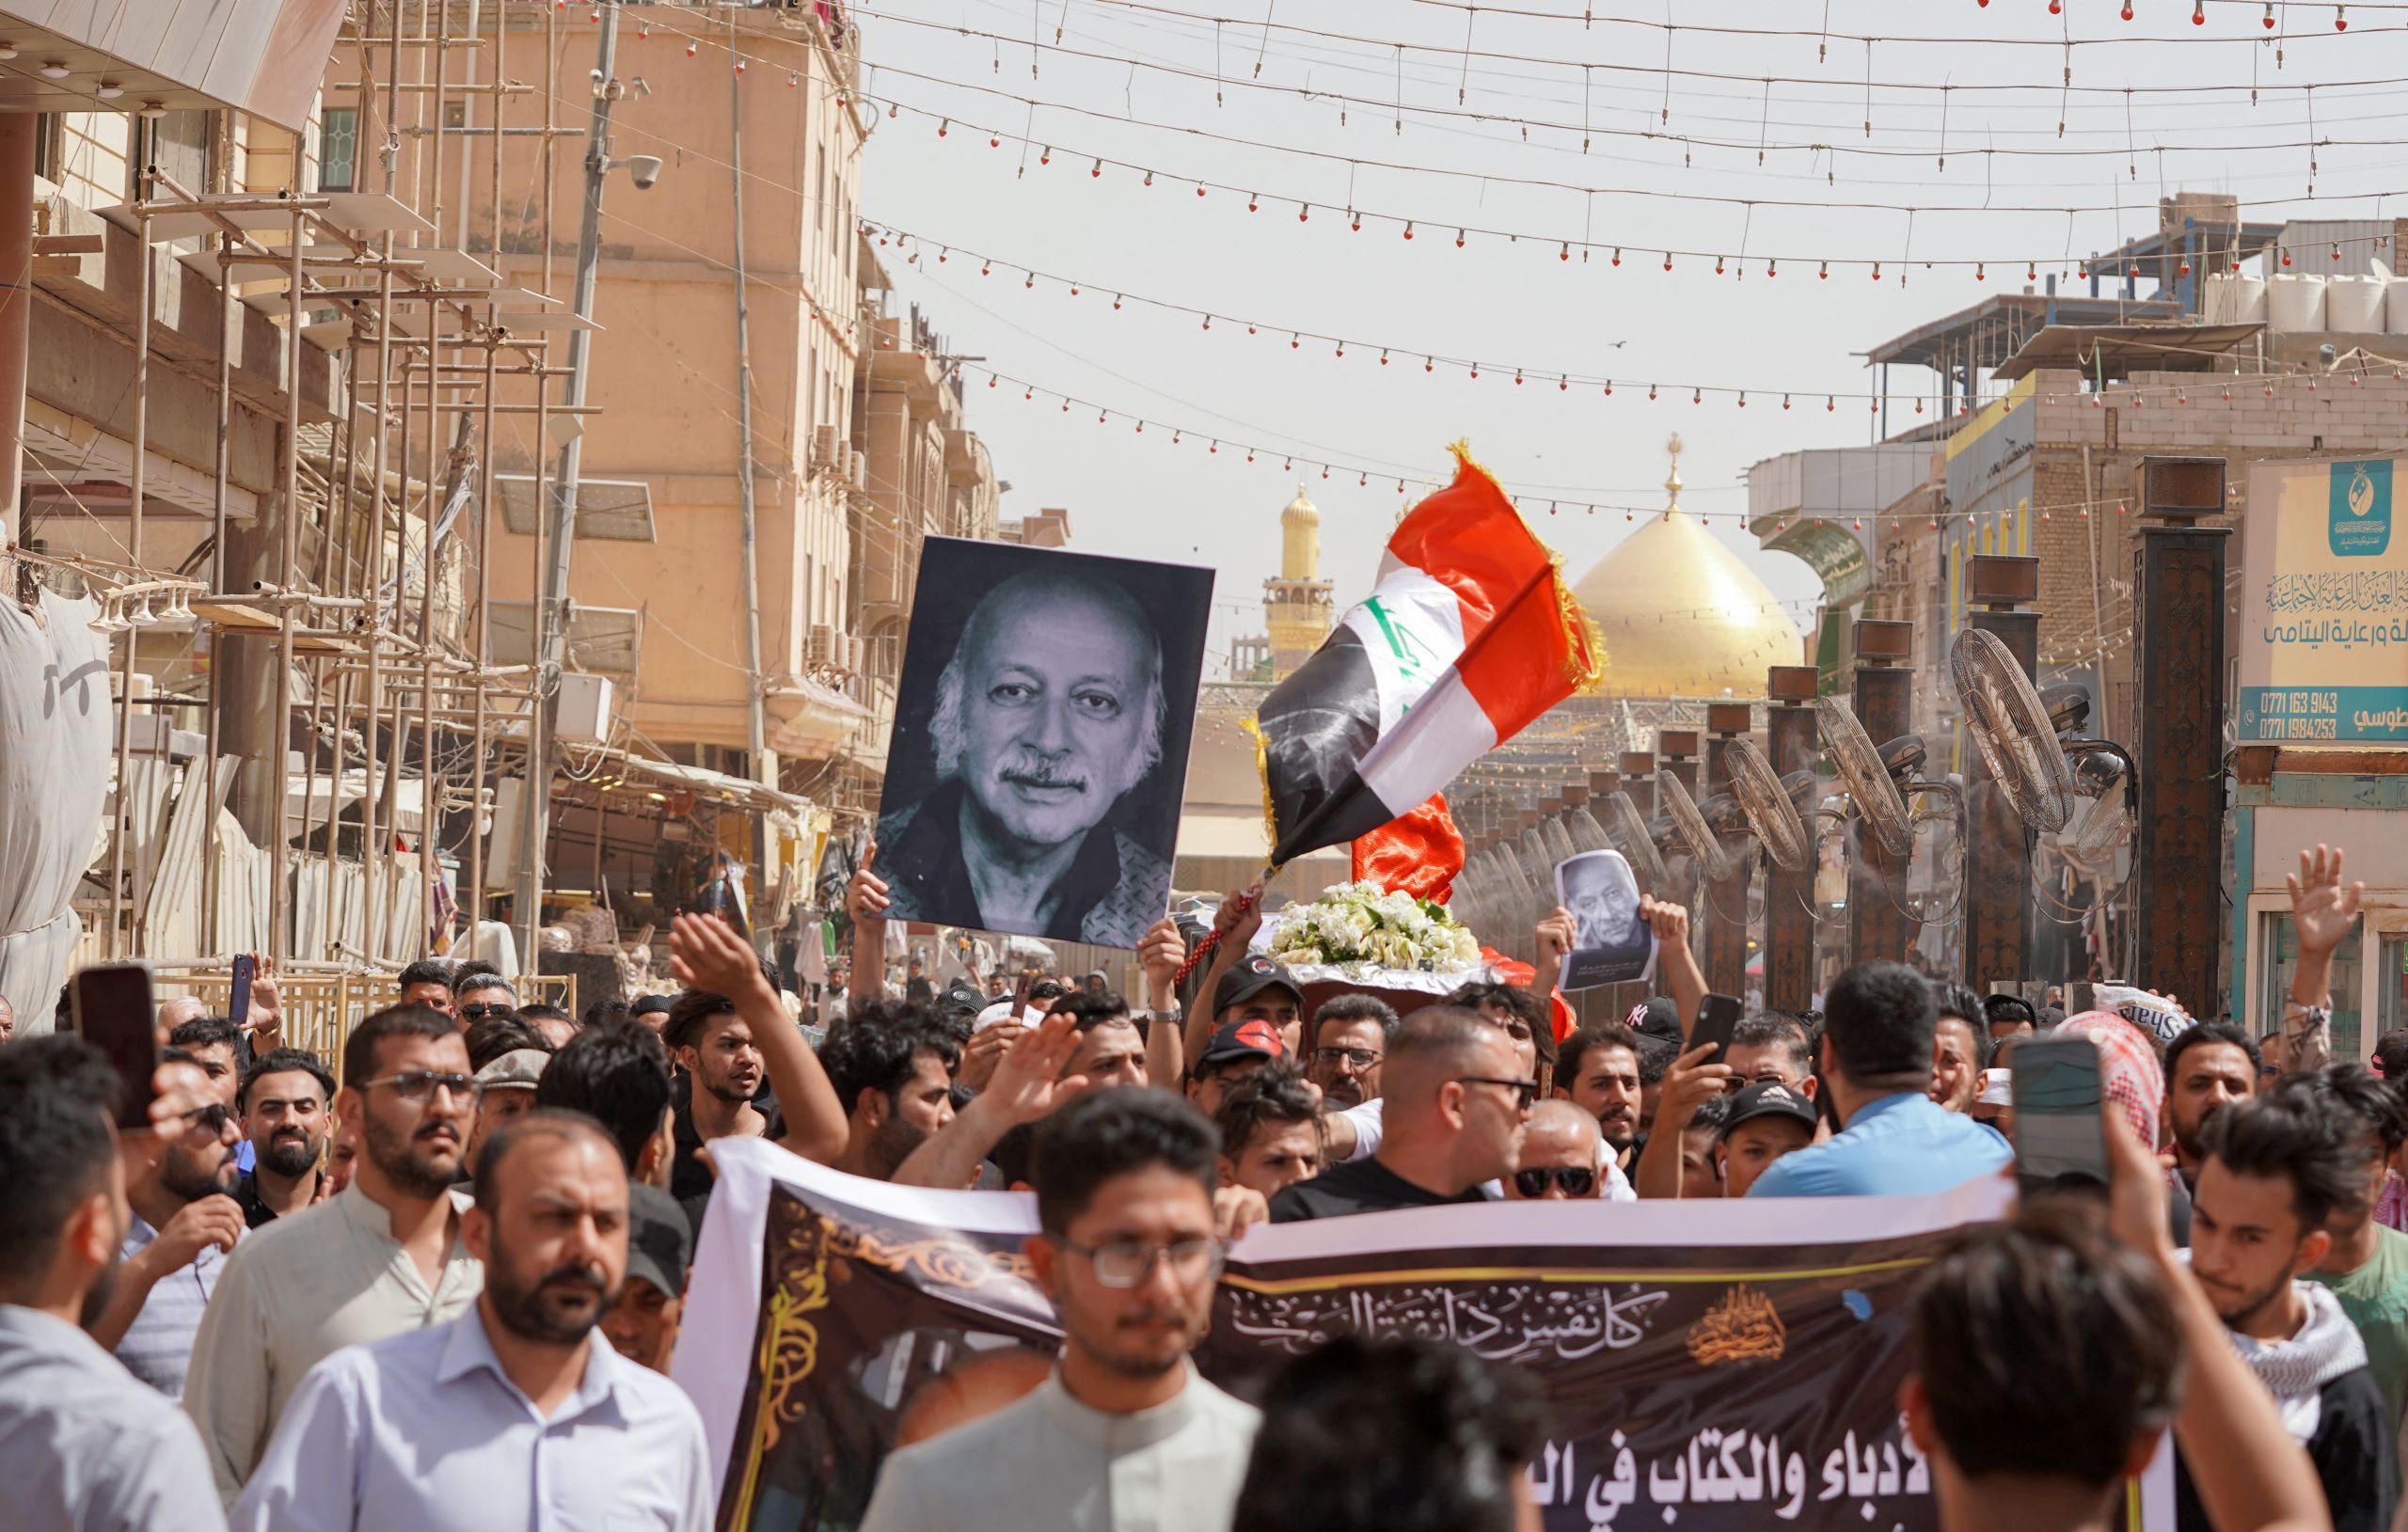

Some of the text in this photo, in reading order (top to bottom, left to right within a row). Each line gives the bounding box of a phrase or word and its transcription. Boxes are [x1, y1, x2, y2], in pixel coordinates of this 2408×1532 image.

[2263, 619, 2329, 650] اليتامى
[2332, 618, 2387, 650] ورعاية
[2260, 692, 2337, 714] 0771 163 9143
[2259, 718, 2337, 739] 0771 1984253
[2353, 707, 2408, 732] طوسي
[1584, 1428, 1638, 1532] في
[1649, 1427, 1806, 1525] والكتاب
[1817, 1410, 1931, 1522] لأدباء
